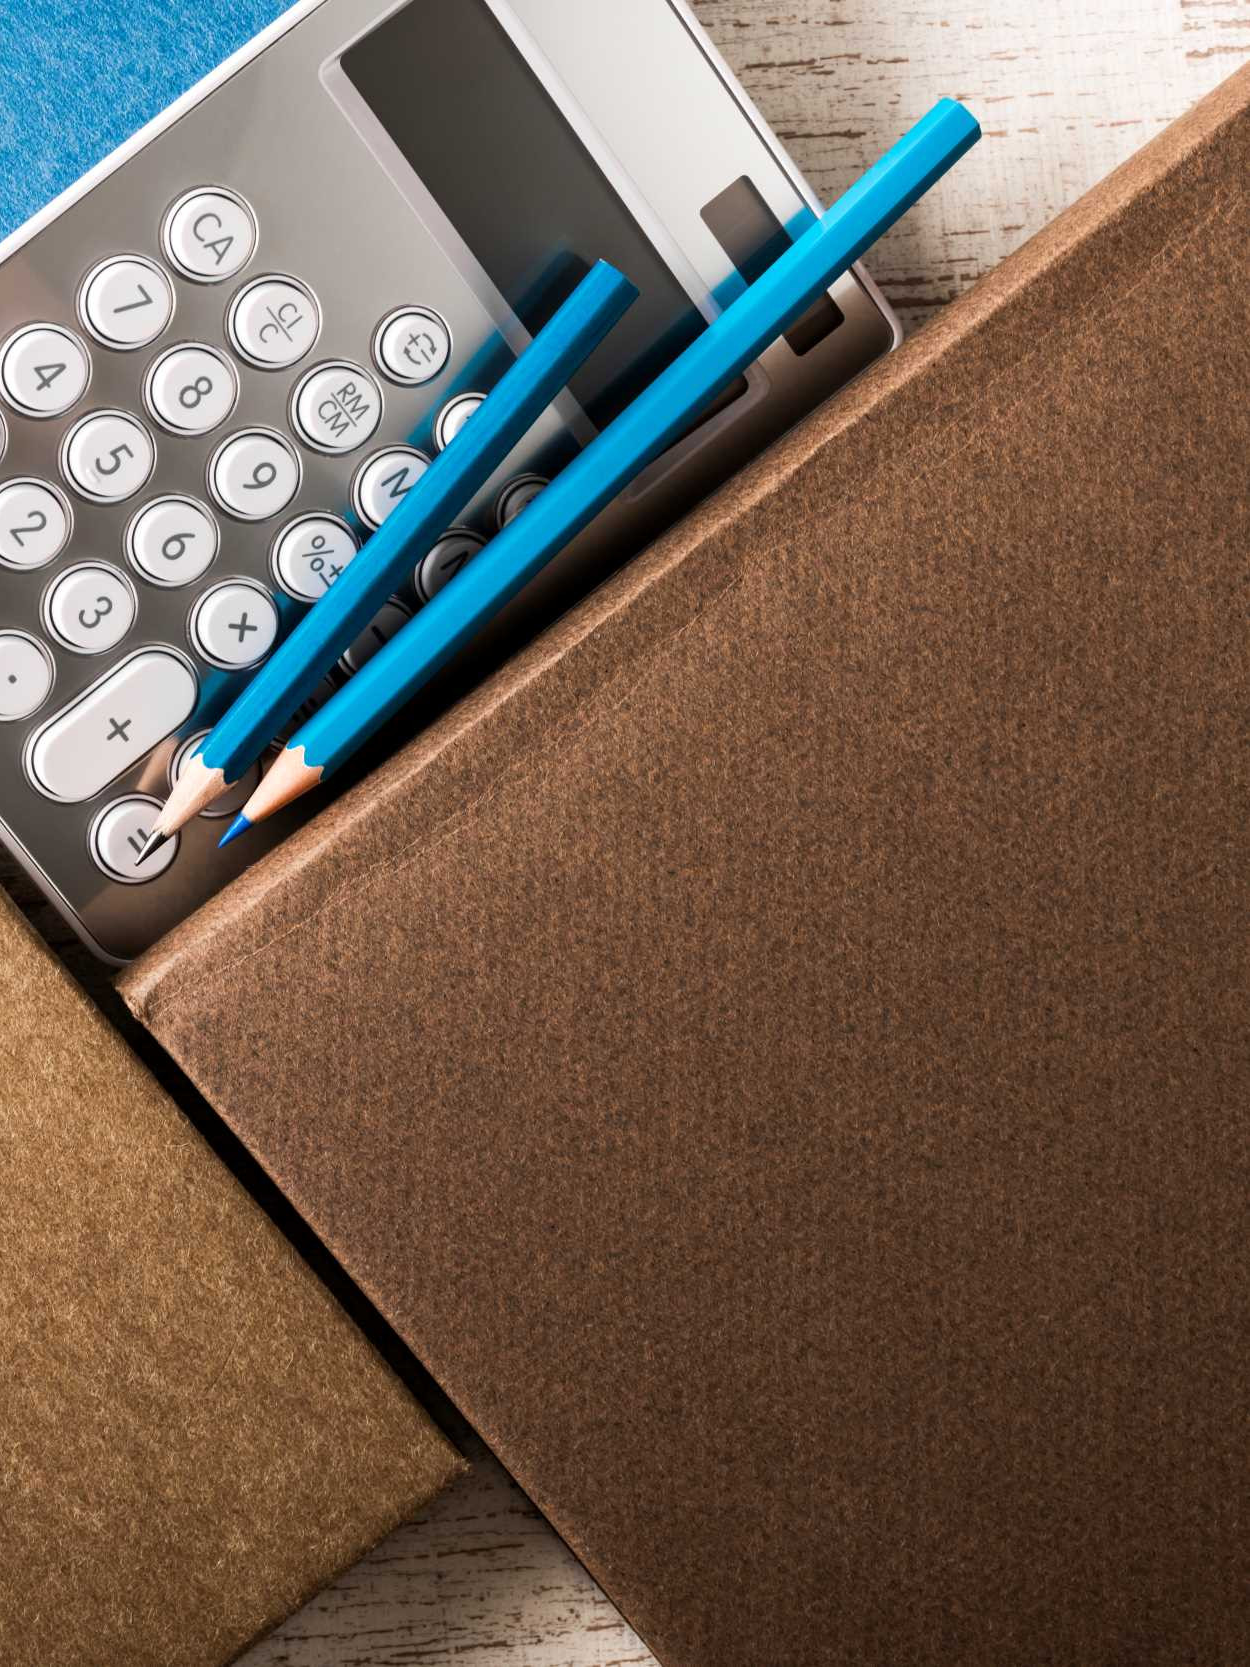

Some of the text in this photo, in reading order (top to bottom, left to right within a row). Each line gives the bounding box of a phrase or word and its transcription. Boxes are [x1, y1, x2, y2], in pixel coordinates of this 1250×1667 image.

[193, 212, 234, 265] CA
[114, 285, 153, 313] 7
[259, 322, 279, 343] C
[34, 363, 66, 391] 4
[179, 376, 212, 408] 8
[318, 396, 349, 437] CM
[337, 382, 370, 420] RM
[96, 444, 133, 475] 5
[243, 462, 276, 489] 9
[10, 511, 46, 546] 2
[162, 533, 195, 560] 6
[79, 597, 112, 628] 3
